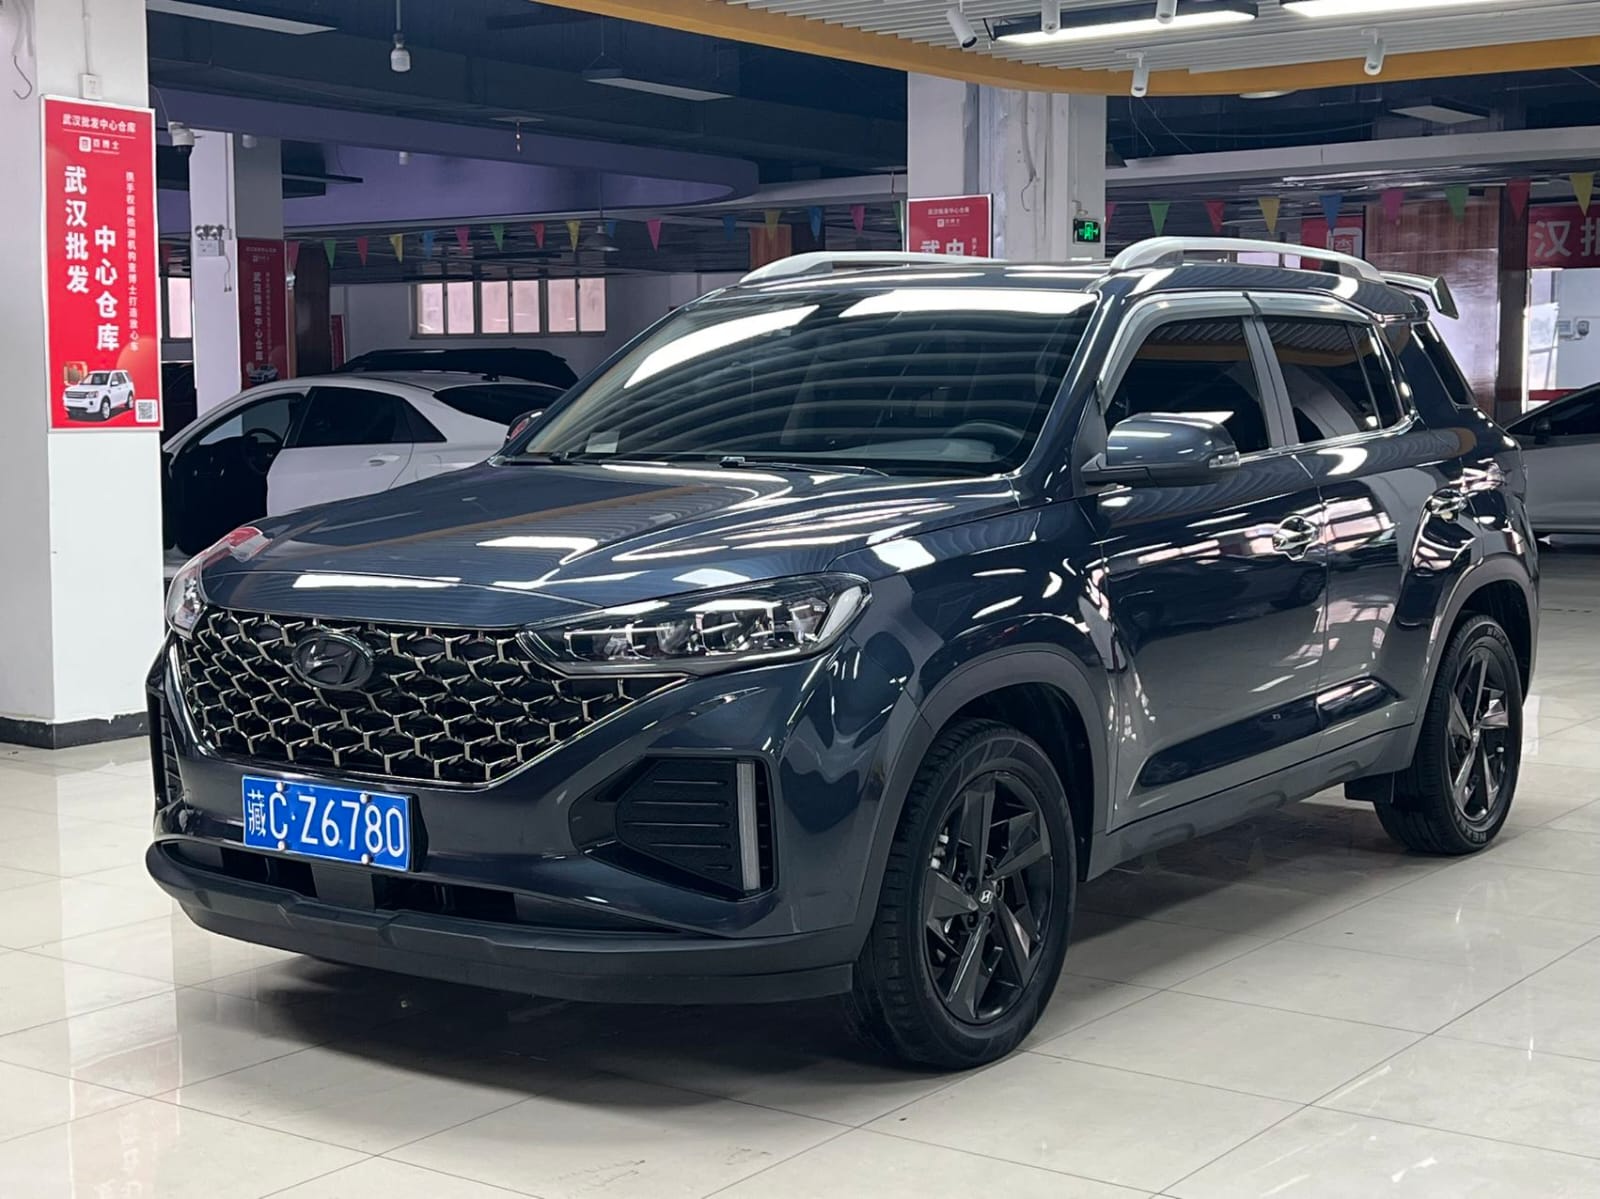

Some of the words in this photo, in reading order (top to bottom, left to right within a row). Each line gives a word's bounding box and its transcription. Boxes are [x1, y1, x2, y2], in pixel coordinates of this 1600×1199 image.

[63, 113, 136, 133] 武汉批发中心仓库
[64, 165, 90, 294] 武汉批发
[94, 225, 120, 351] 中心仓库
